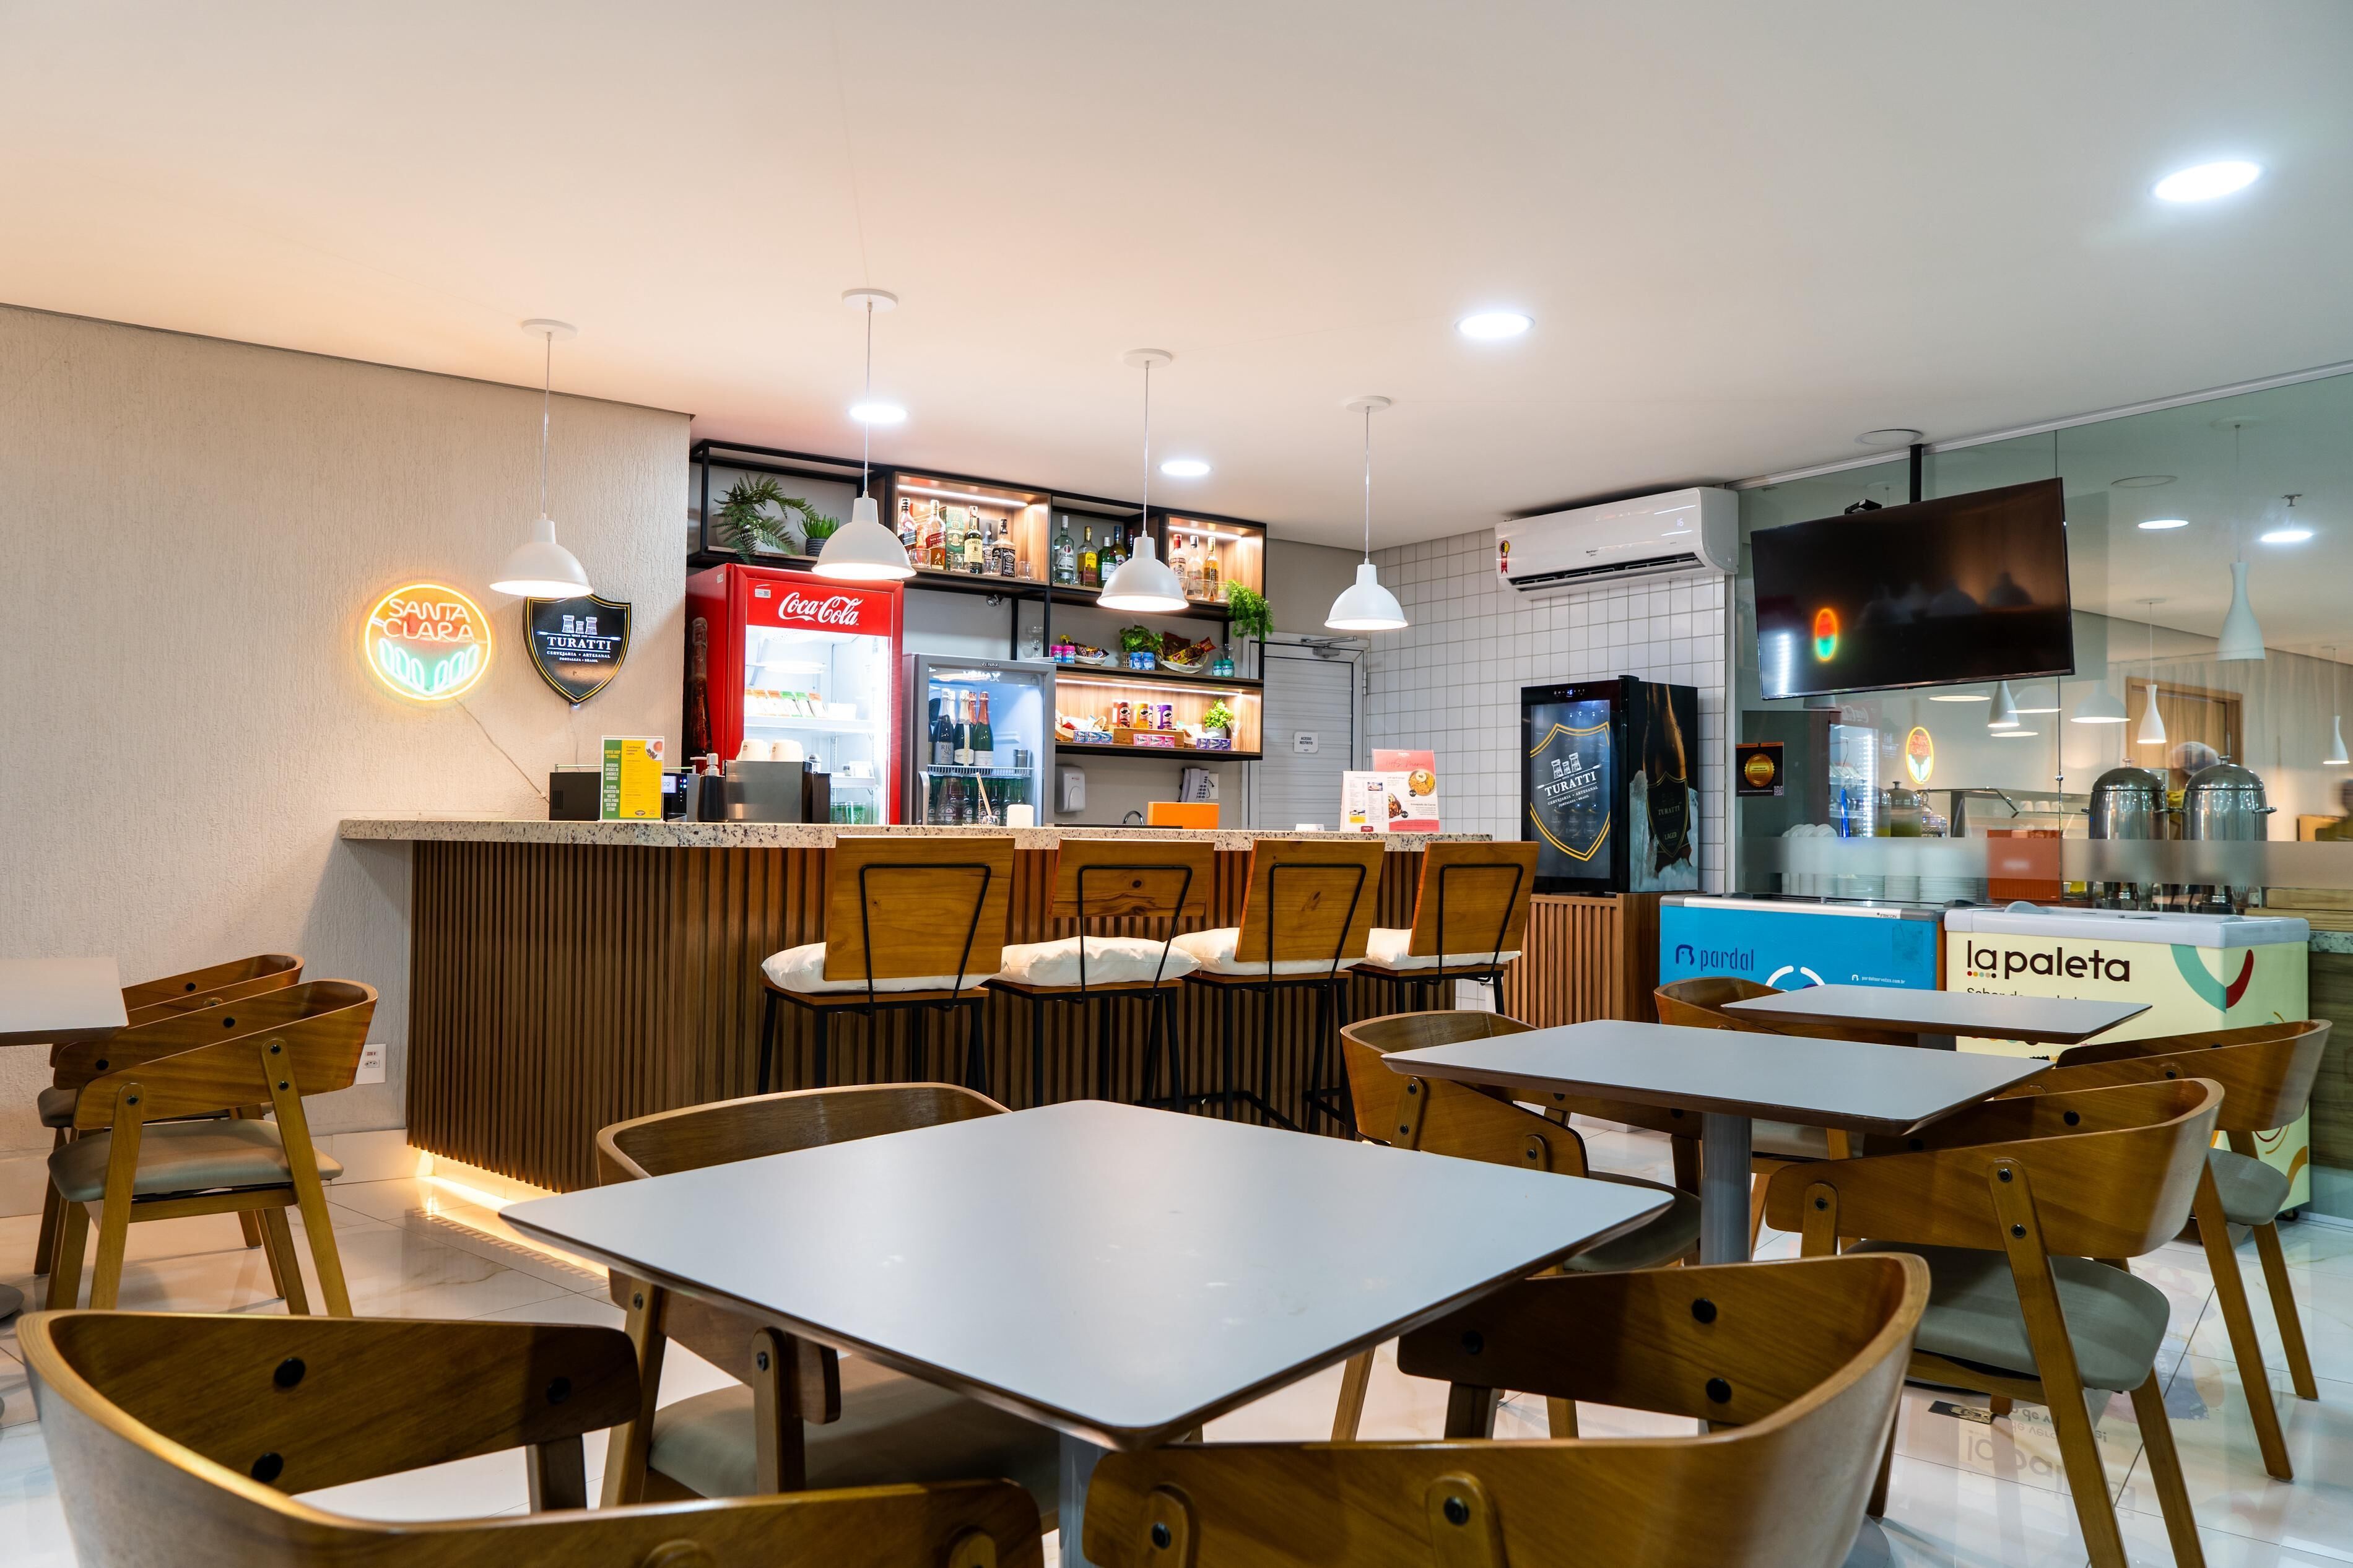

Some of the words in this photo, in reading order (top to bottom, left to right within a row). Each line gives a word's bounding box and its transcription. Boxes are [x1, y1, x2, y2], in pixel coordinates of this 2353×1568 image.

[1677, 518, 1684, 526] 16
[388, 598, 471, 623] SANTA
[778, 592, 864, 625] Coca-Cola
[383, 618, 476, 643] CLARA
[547, 636, 611, 651] TURATTI
[1544, 771, 1597, 797] TURATTI
[1547, 795, 1572, 805] CERVEJARIA
[1575, 786, 1598, 796] ARTESANAL
[1658, 805, 1680, 816] TURATTI
[1664, 831, 1677, 840] LAGER
[1700, 948, 1754, 971] pardal
